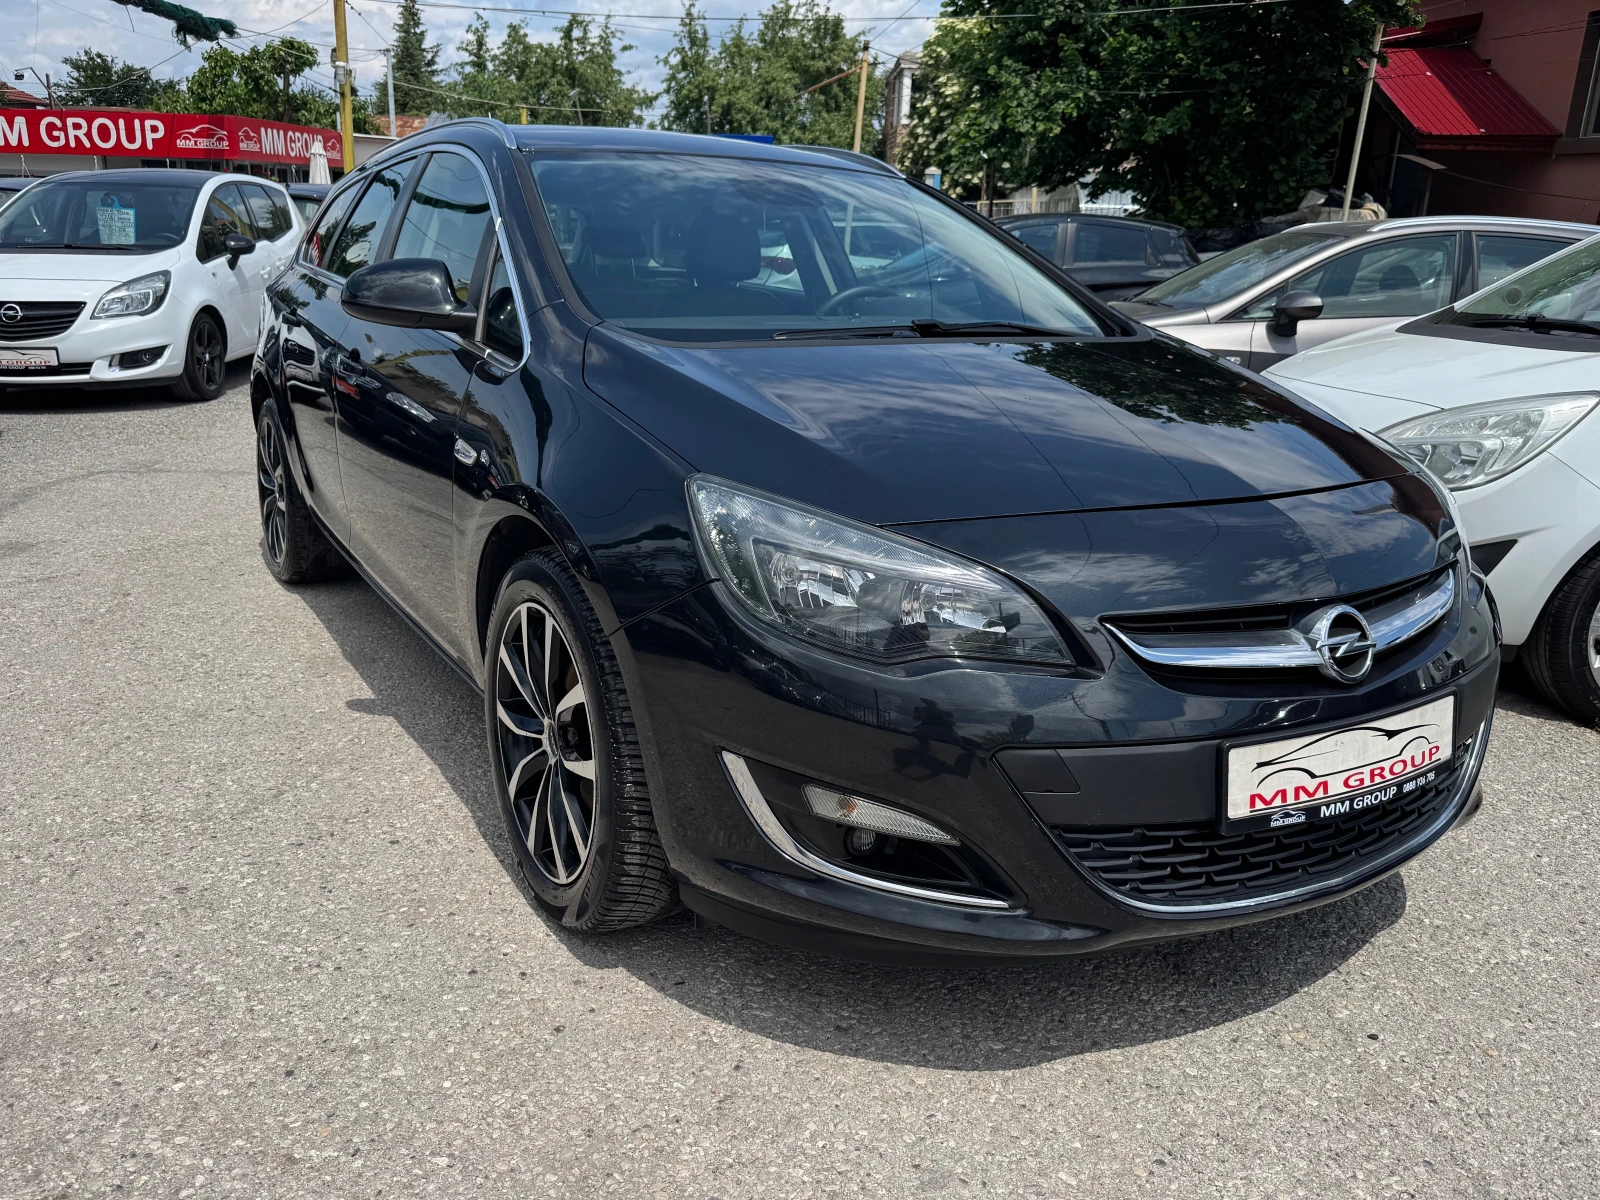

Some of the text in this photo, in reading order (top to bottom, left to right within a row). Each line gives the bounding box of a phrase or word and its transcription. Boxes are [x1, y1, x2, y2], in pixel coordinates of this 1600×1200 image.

[39, 116, 165, 150] GROUP
[176, 139, 229, 148] MM GROUP
[261, 126, 286, 156] MM
[1249, 745, 1441, 809] MM GROUP
[1320, 800, 1350, 818] MM
[1353, 786, 1398, 810] GROUP
[1403, 780, 1416, 793] 0888
[1270, 815, 1306, 828] MM GROUP
